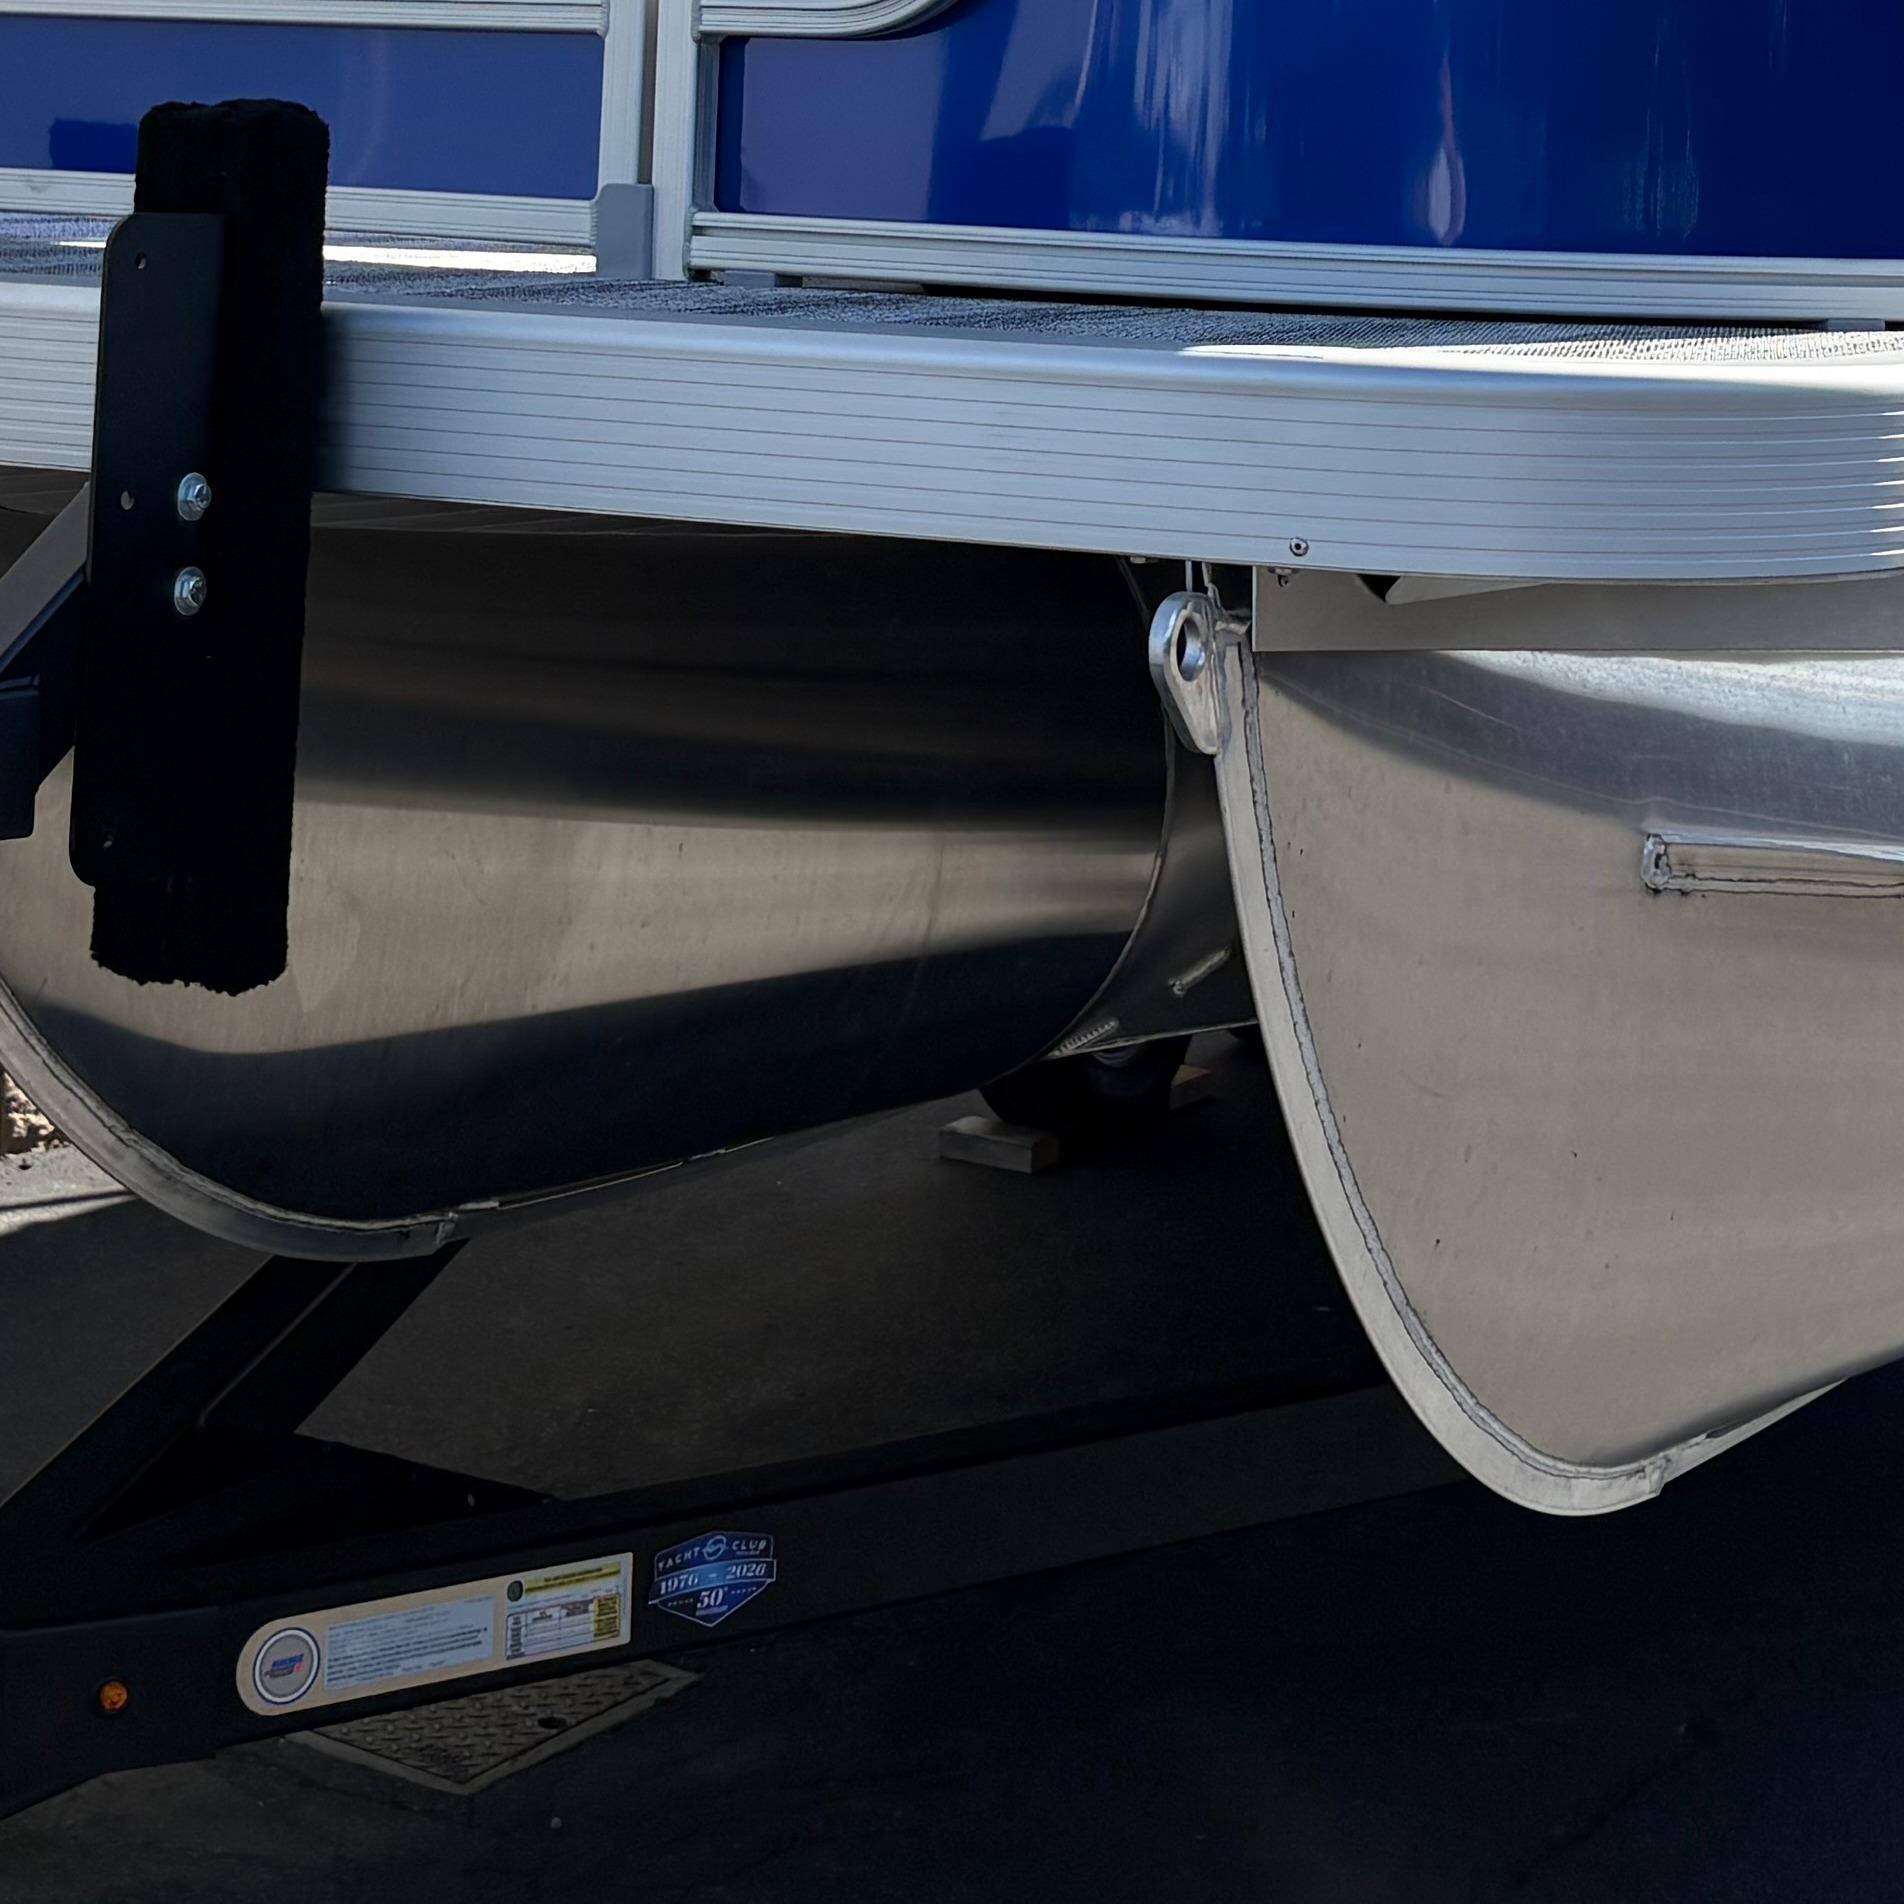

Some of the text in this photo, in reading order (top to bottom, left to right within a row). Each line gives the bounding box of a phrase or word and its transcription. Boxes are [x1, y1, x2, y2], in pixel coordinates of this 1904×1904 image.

[658, 1539, 767, 1572] YACHT CLUB
[660, 1573, 699, 1595] 1976
